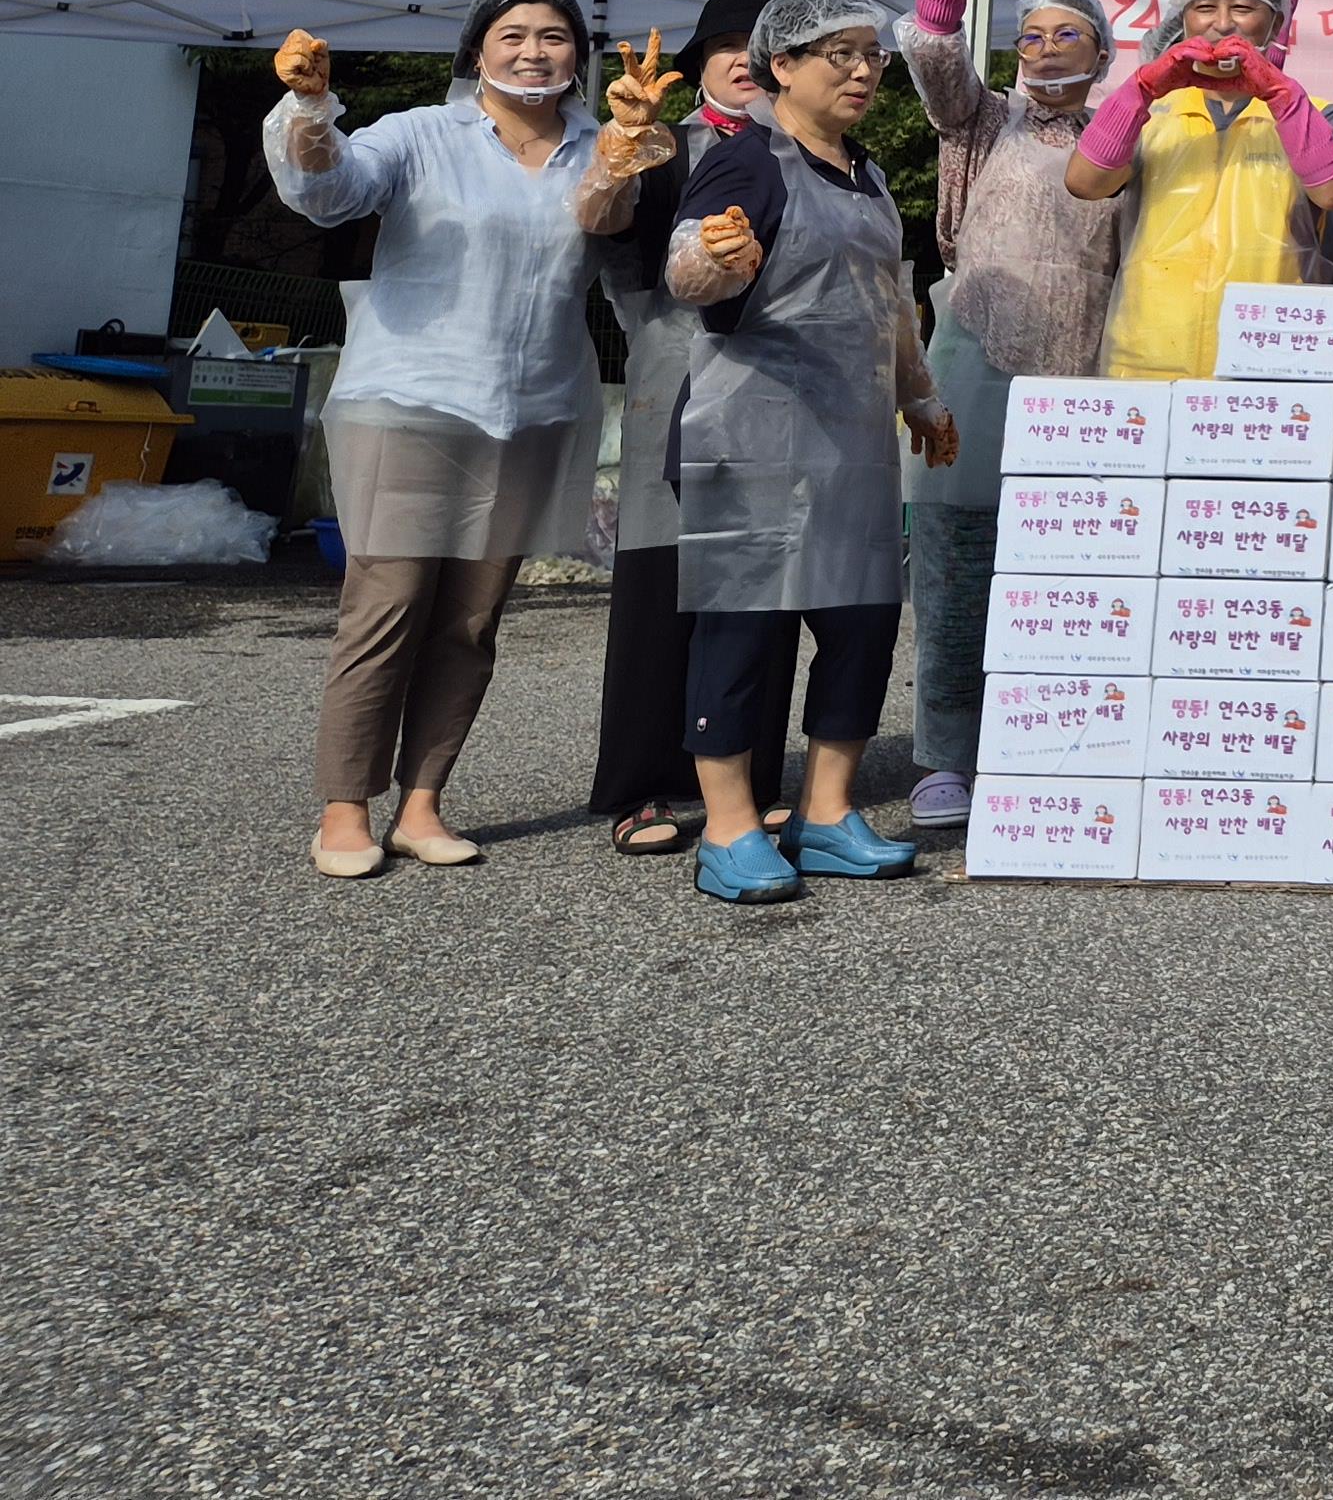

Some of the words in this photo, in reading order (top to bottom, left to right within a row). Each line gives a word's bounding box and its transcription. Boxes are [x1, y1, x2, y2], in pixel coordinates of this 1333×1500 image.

[1234, 303, 1267, 322] 띵동!
[1274, 306, 1328, 326] 연수3동
[1239, 331, 1282, 349] 사랑의
[1290, 332, 1320, 352] 반찬
[1023, 397, 1055, 414] 띵동!
[1063, 398, 1116, 417] 연수3동
[1027, 424, 1070, 443] 사랑의
[1079, 425, 1109, 445] 반찬
[1115, 427, 1145, 445] 배달
[1185, 499, 1222, 520] 띵동!
[1230, 500, 1290, 522] 연수3동
[1178, 530, 1225, 551] 사랑의
[1234, 531, 1266, 552] 반찬
[1275, 533, 1308, 554] 배달
[1005, 590, 1039, 608] 띵동!
[1046, 590, 1100, 610] 연수3동
[1010, 618, 1053, 637] 사랑의
[1062, 619, 1093, 638] 반찬
[1100, 619, 1130, 638] 배달
[1171, 699, 1210, 720] 띵동!
[1217, 700, 1278, 723] 연수3동
[1162, 731, 1211, 752] 사랑의
[1220, 732, 1256, 754] 반찬
[1263, 734, 1297, 756] 배달
[986, 795, 1020, 813] 띵동!
[1028, 795, 1084, 816] 연수3동
[992, 824, 1036, 843] 사랑의
[1045, 825, 1076, 844] 반찬
[1083, 826, 1114, 845] 배달
